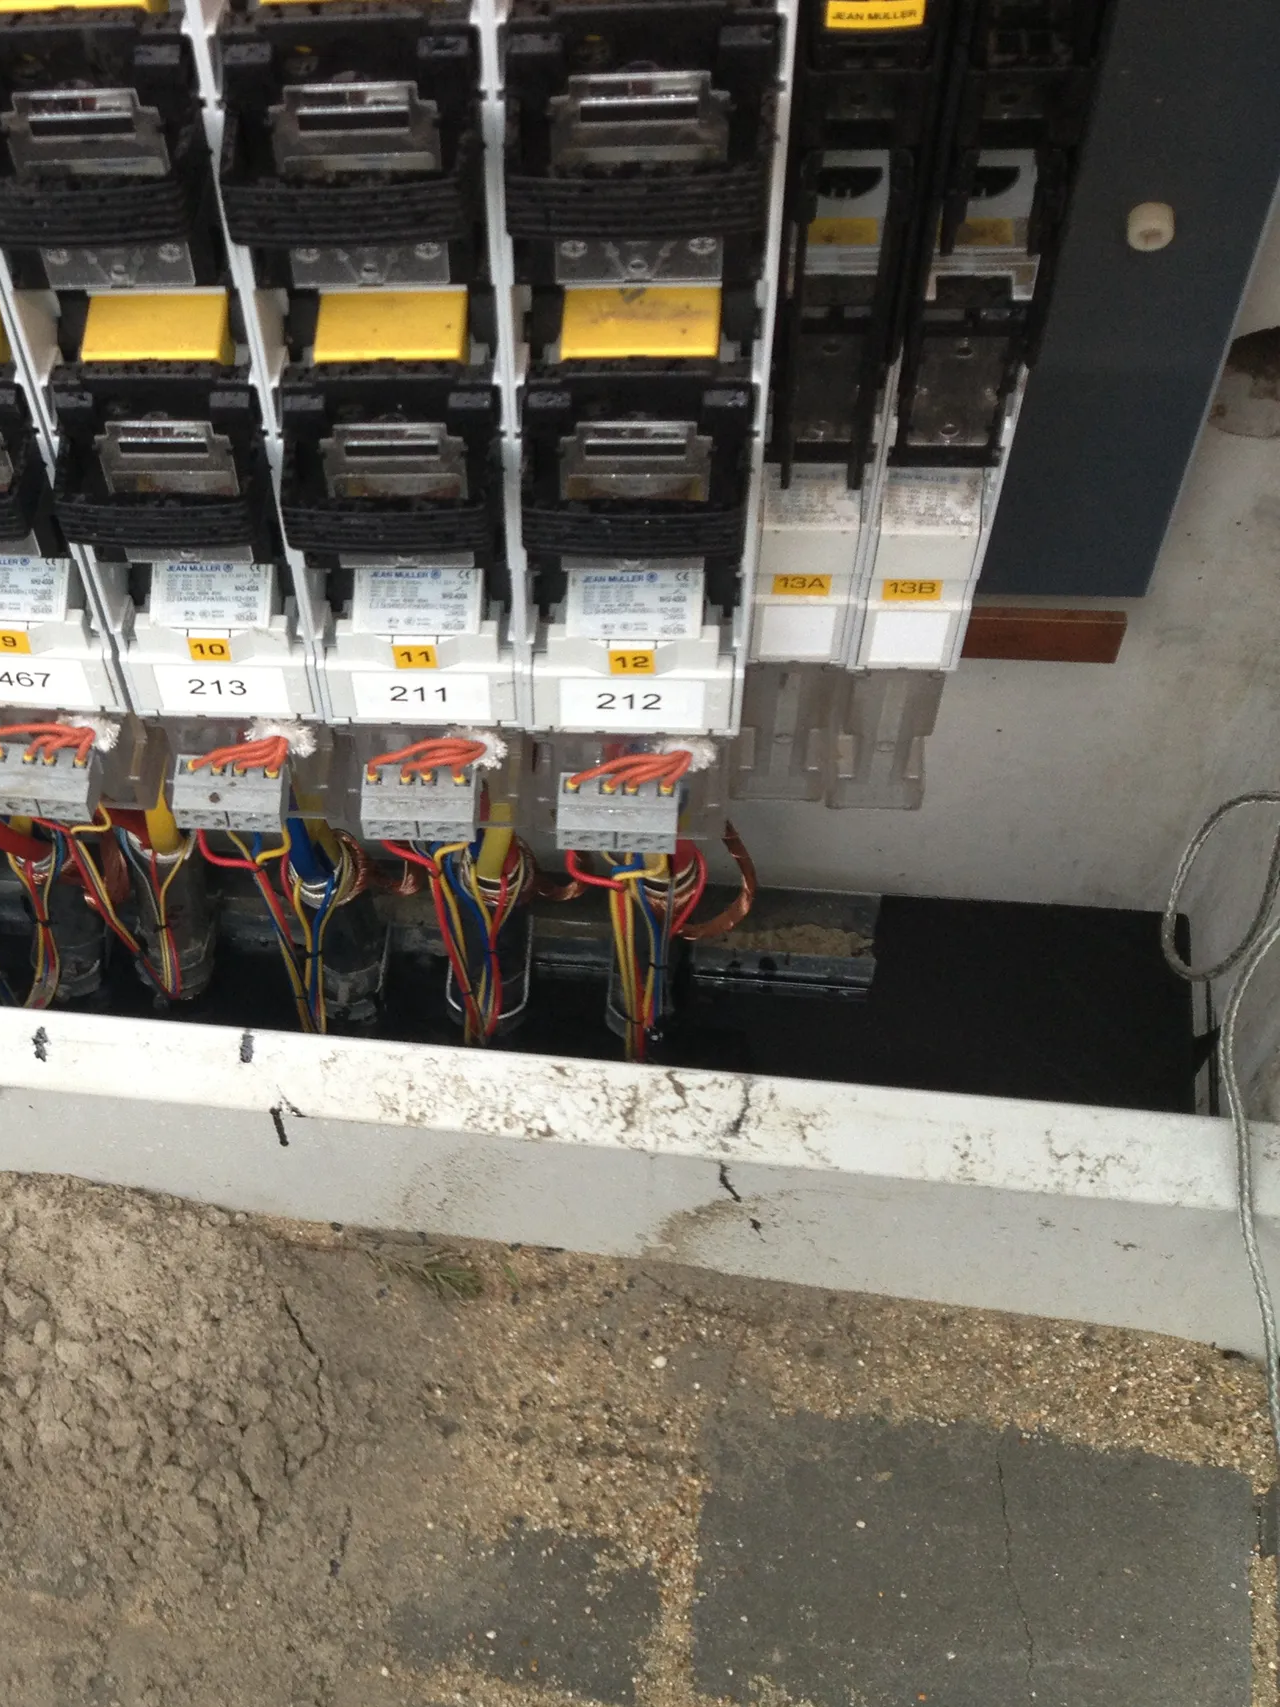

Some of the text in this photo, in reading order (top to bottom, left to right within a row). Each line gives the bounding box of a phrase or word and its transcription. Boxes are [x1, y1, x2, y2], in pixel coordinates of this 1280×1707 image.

[832, 11, 864, 20] JEAN
[167, 563, 187, 572] JEAN
[583, 575, 606, 583] JEAN
[779, 577, 825, 590] 13A
[889, 582, 937, 595] 13B
[1, 635, 17, 648] 9
[193, 643, 225, 656] 10
[400, 650, 431, 663] 11
[614, 655, 649, 669] 12
[188, 678, 247, 696] 213
[390, 685, 447, 703] 211
[596, 692, 662, 710] 212
